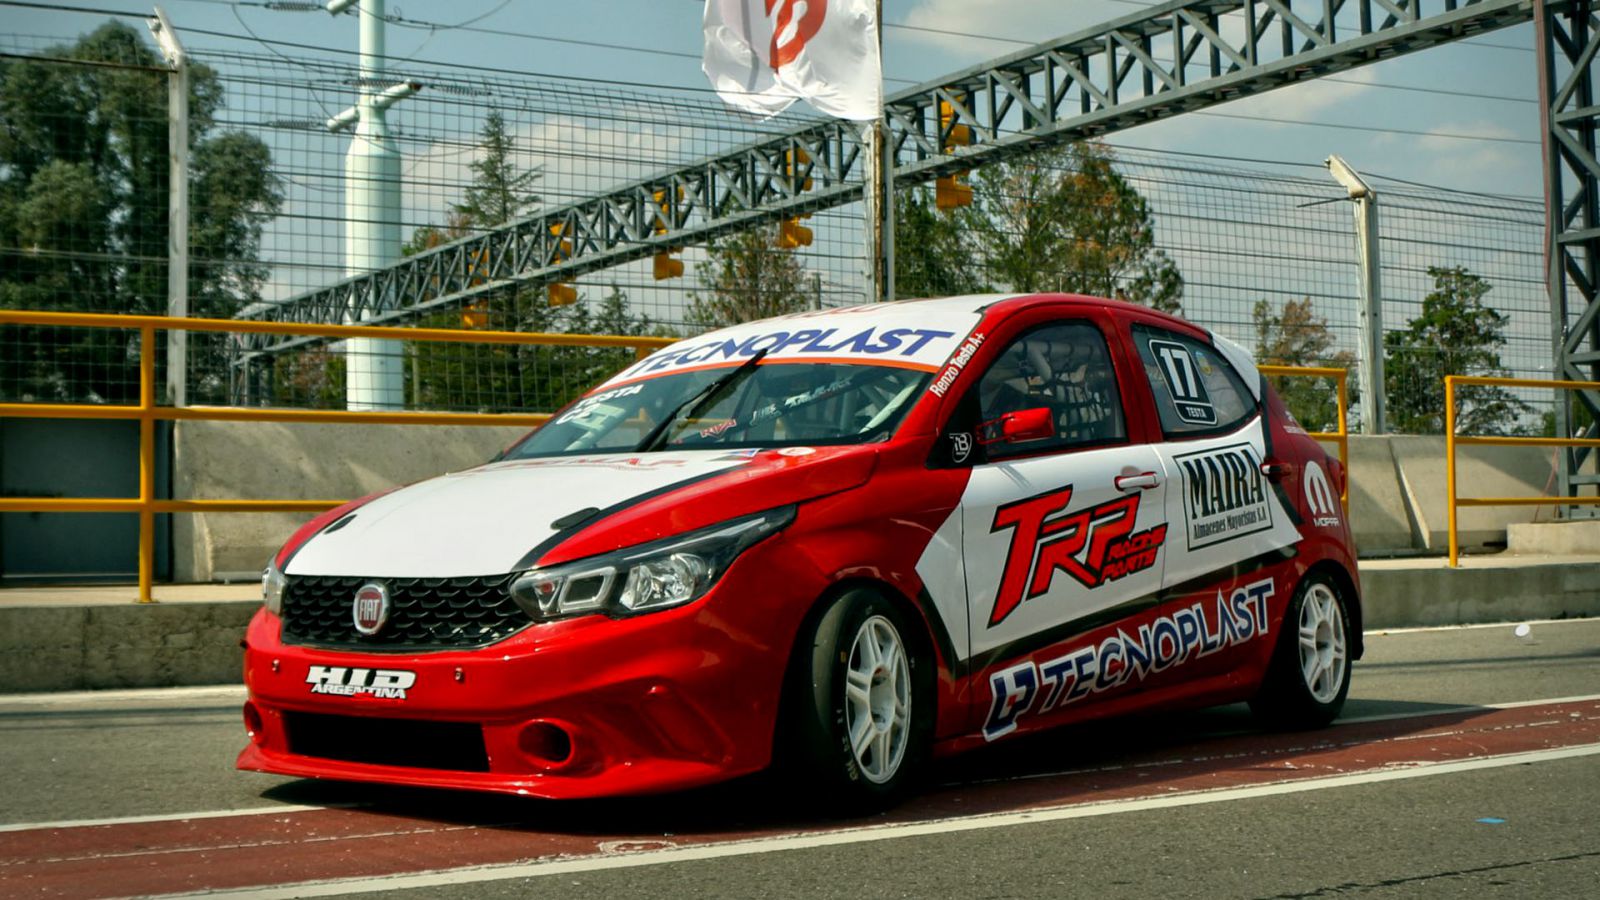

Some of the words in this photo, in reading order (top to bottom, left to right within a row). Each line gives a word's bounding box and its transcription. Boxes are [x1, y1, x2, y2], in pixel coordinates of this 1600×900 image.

[627, 326, 955, 377] TECNOPLAST
[929, 366, 959, 398] Renzo
[950, 342, 977, 369] Testa
[1160, 347, 1198, 398] 17
[1185, 406, 1207, 418] TESTA
[1184, 450, 1264, 520] MAIRA
[1194, 522, 1226, 540] Almacenes
[1226, 510, 1257, 530] Mayoristas
[1313, 517, 1339, 527] MOPAR
[987, 484, 1141, 629] TRP
[1100, 546, 1158, 584] PARTS
[359, 599, 380, 621] FIAT
[1038, 577, 1275, 714] TECNOPLAST
[311, 683, 408, 698] ARGENTINA
